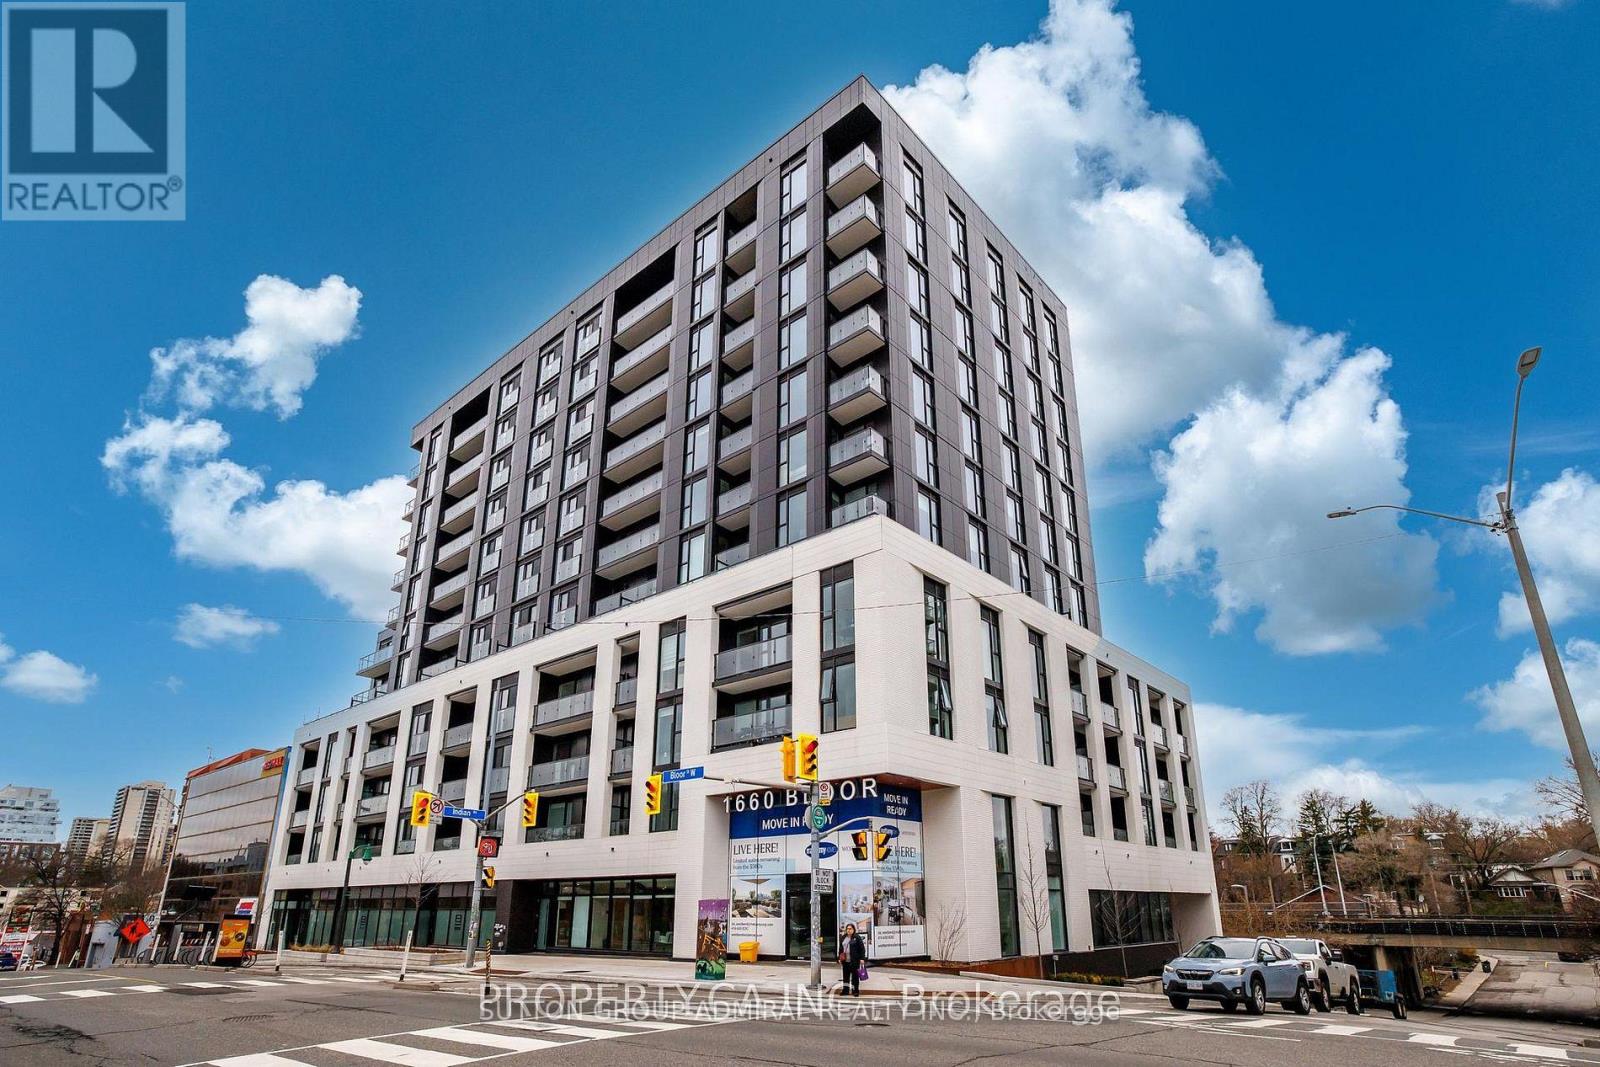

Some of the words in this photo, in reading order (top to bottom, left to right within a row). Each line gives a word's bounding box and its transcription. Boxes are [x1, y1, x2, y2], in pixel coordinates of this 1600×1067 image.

[670, 769, 686, 780] Bloor
[723, 790, 774, 814] 1660
[884, 793, 901, 804] MOVE
[902, 796, 909, 805] IN
[452, 808, 471, 817] Indian
[886, 805, 907, 816] READY
[762, 817, 789, 830] MOVE
[790, 816, 800, 828] IN
[733, 843, 752, 855] LIVE
[753, 842, 779, 854] HERE!
